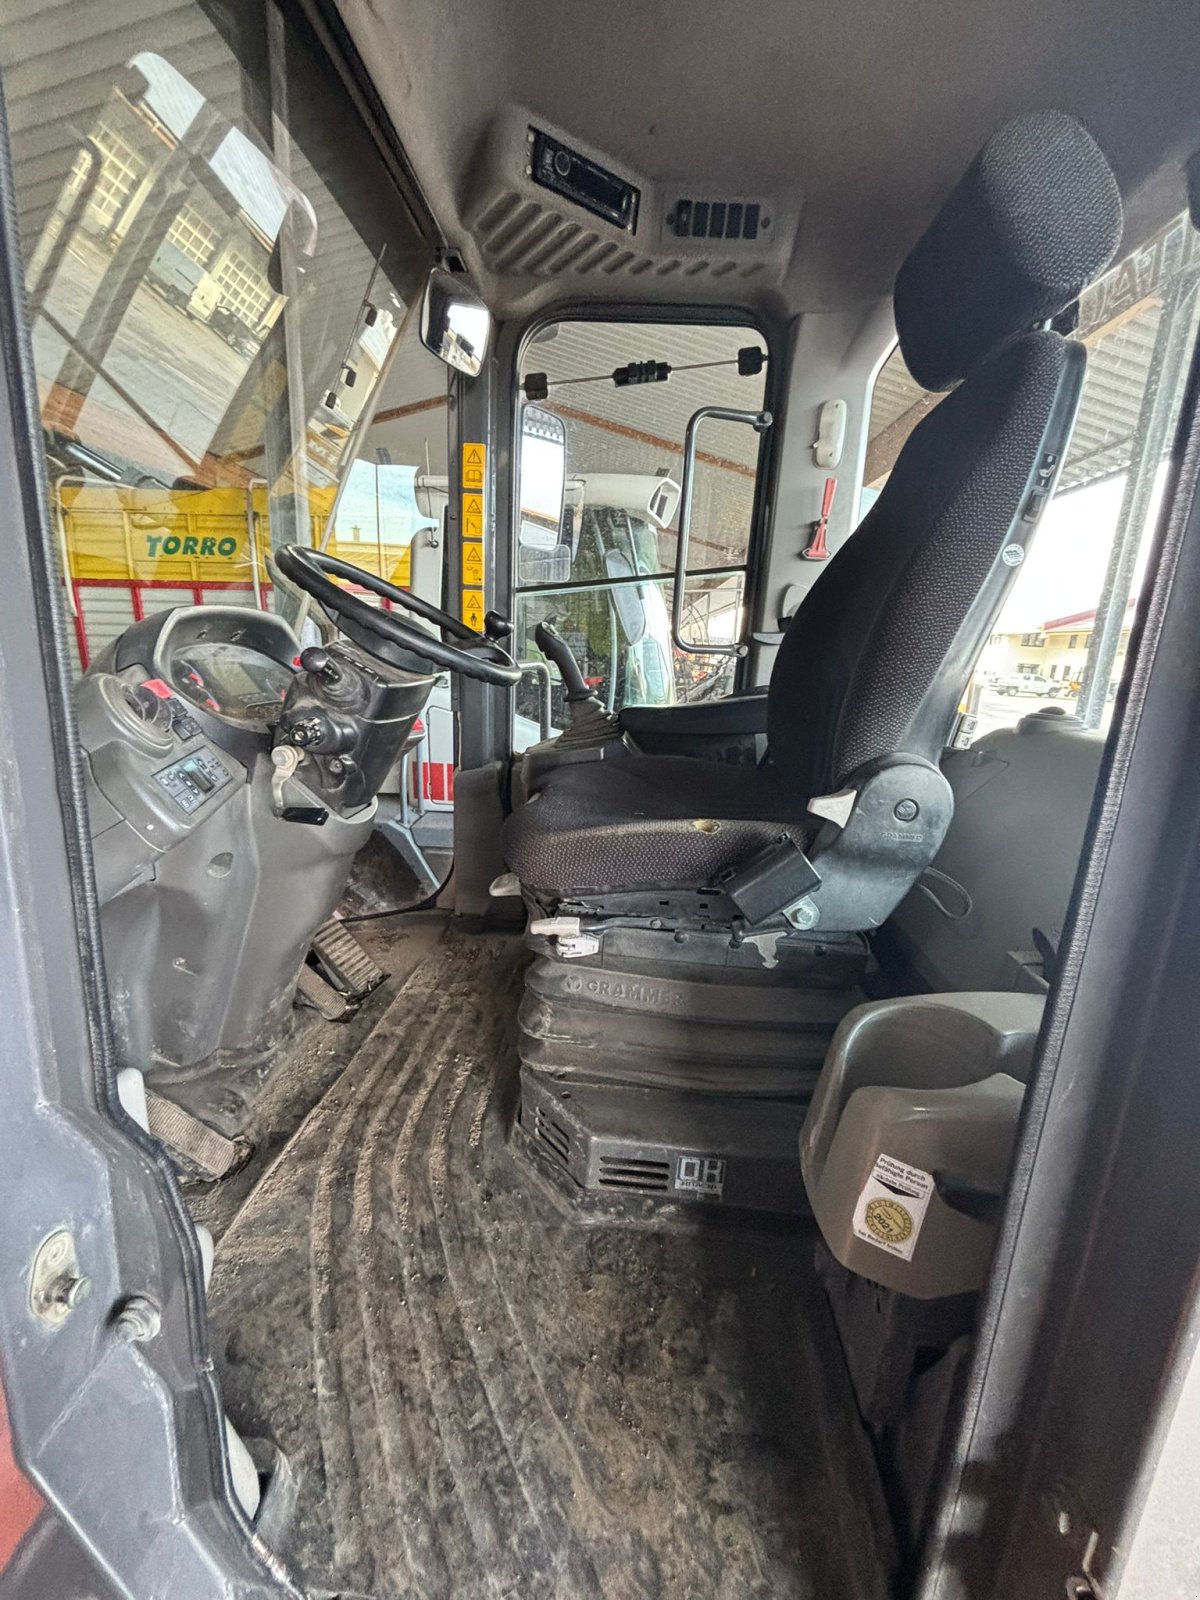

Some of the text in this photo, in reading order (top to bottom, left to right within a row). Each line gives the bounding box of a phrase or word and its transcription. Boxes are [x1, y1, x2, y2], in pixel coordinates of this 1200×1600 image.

[146, 535, 237, 557] TORRO
[879, 1157, 926, 1181] Prüfung durch
[873, 1212, 893, 1233] 2021
